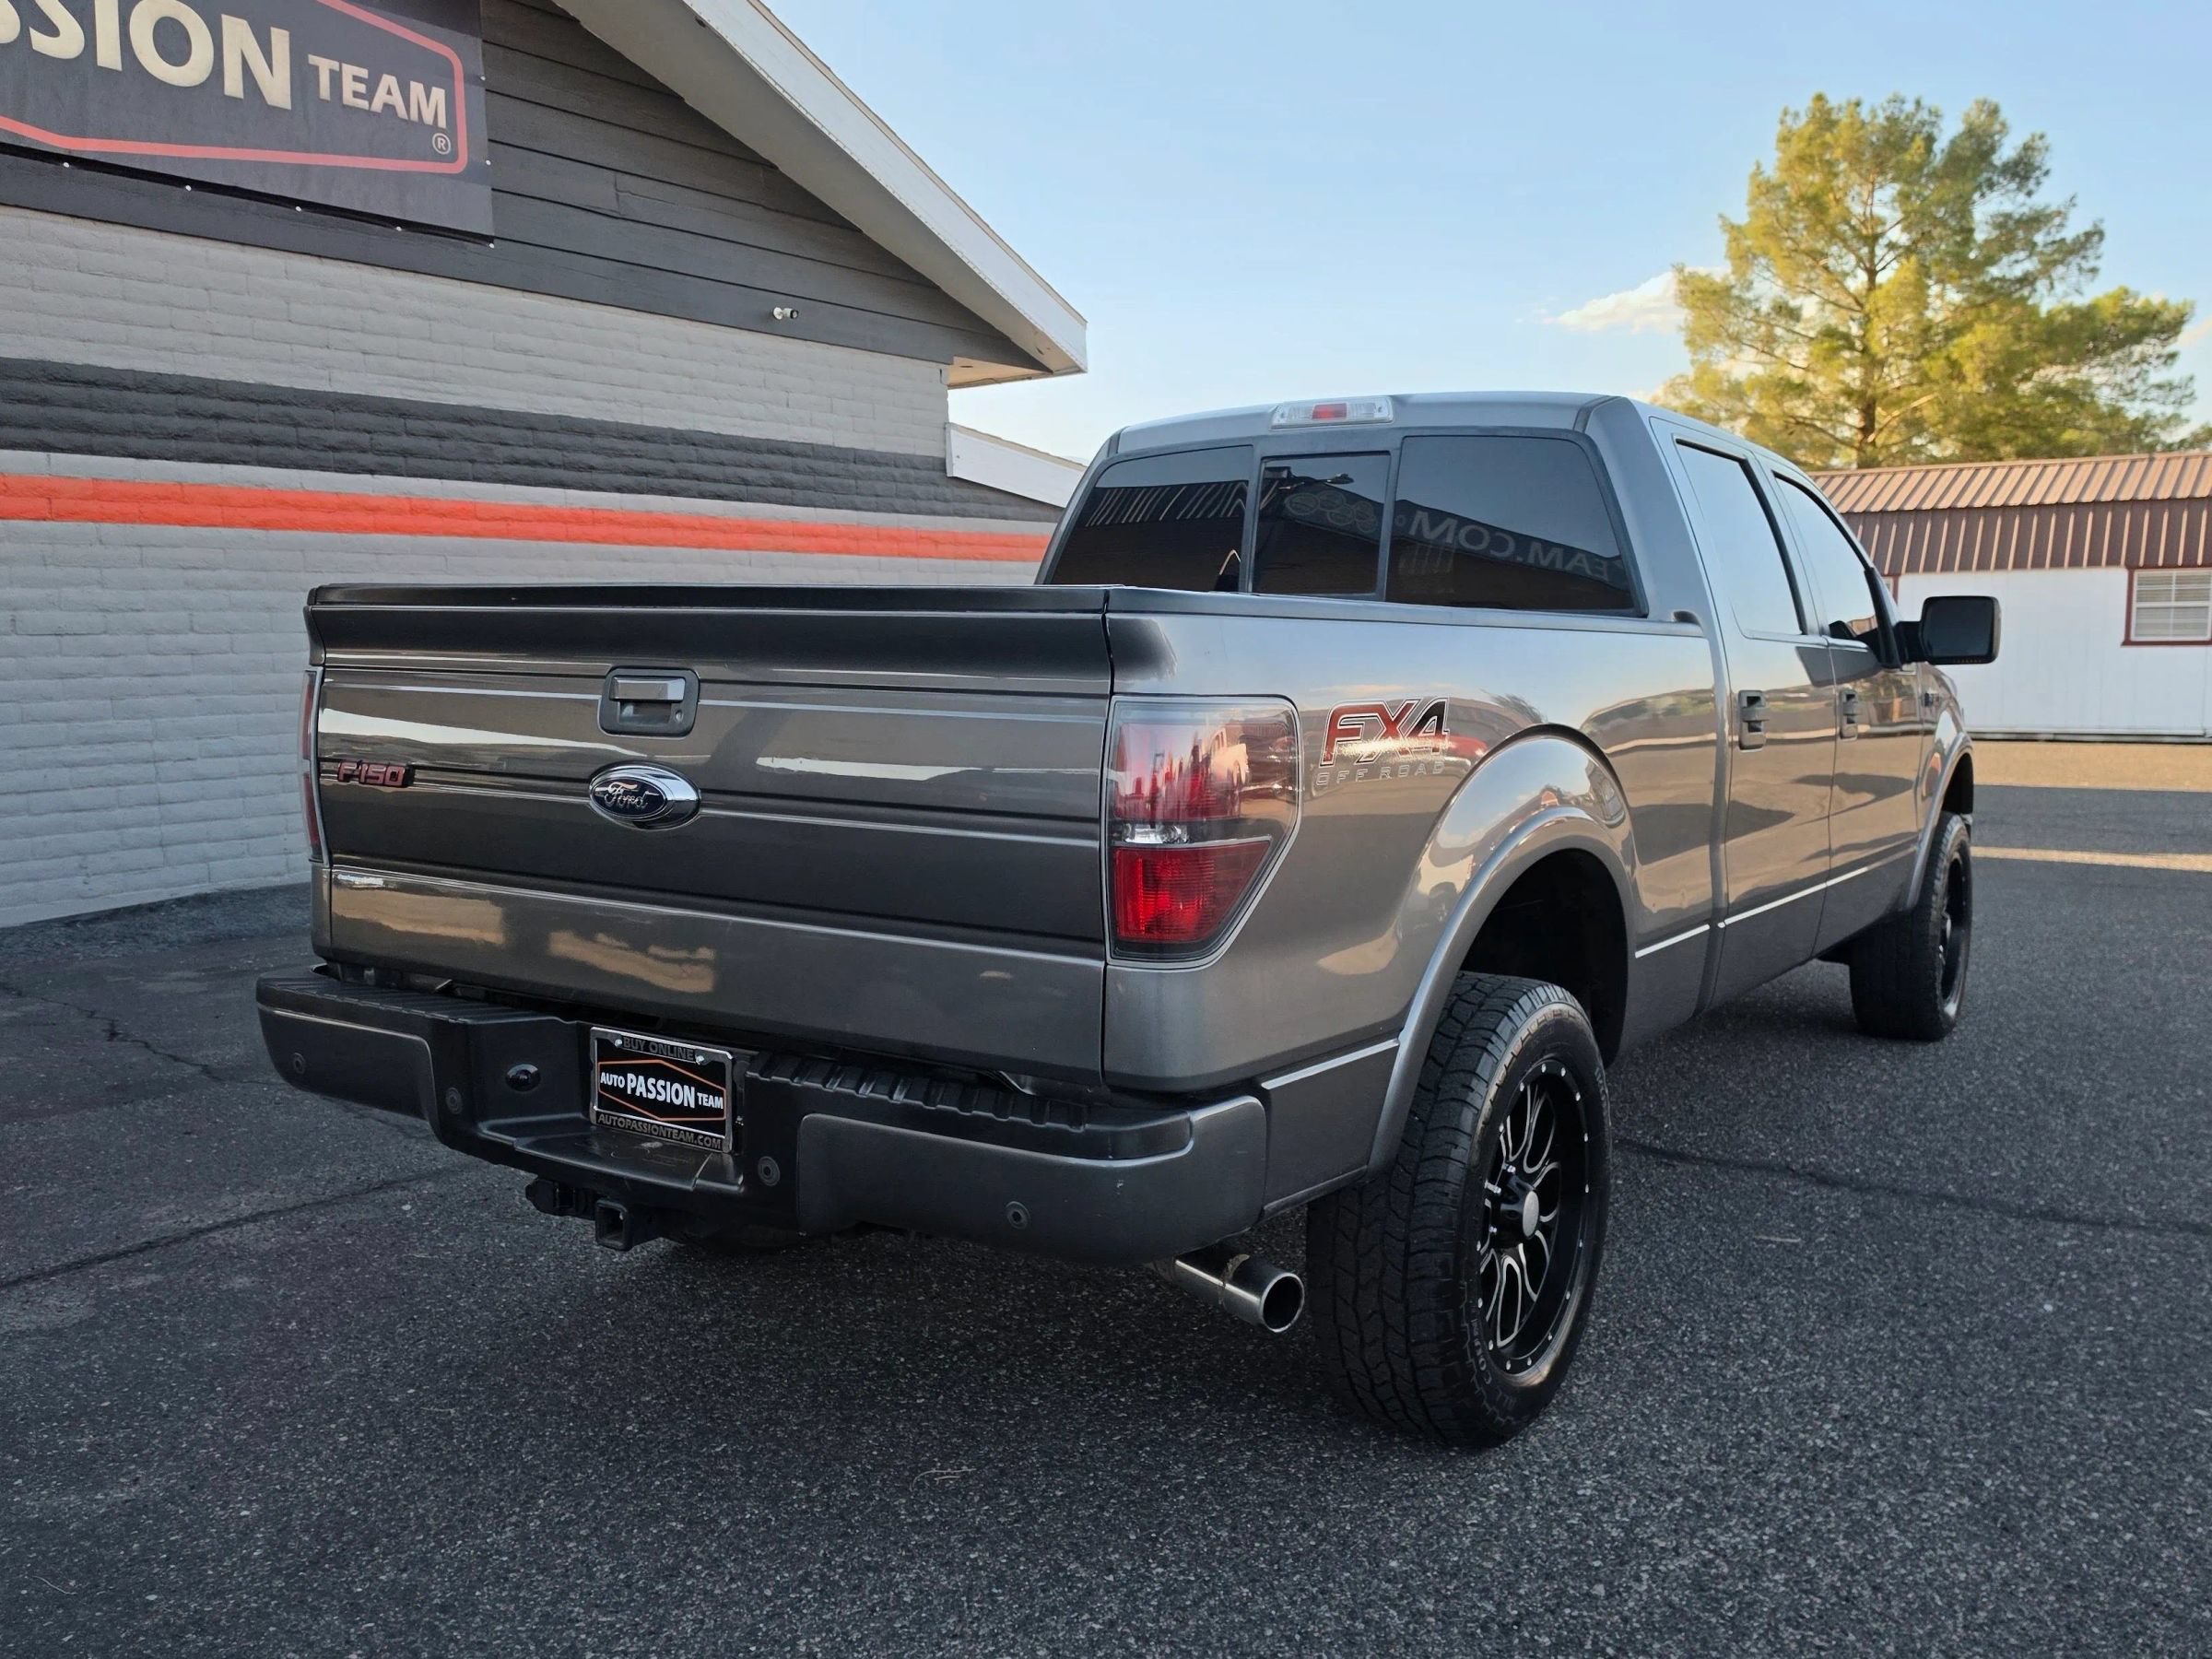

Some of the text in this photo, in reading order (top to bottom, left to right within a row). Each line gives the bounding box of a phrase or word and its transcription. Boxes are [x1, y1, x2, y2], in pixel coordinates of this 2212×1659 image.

[0, 0, 448, 129] SION TEAM
[1319, 697, 1451, 769] FX4
[1315, 760, 1446, 787] OFF ROAD
[594, 782, 661, 809] Ford
[622, 1036, 695, 1060] BUY ONLINE
[600, 1072, 724, 1110] AUTO PASSION TEAM
[597, 1113, 723, 1149] AUTOPASSIONTEAM.COM
